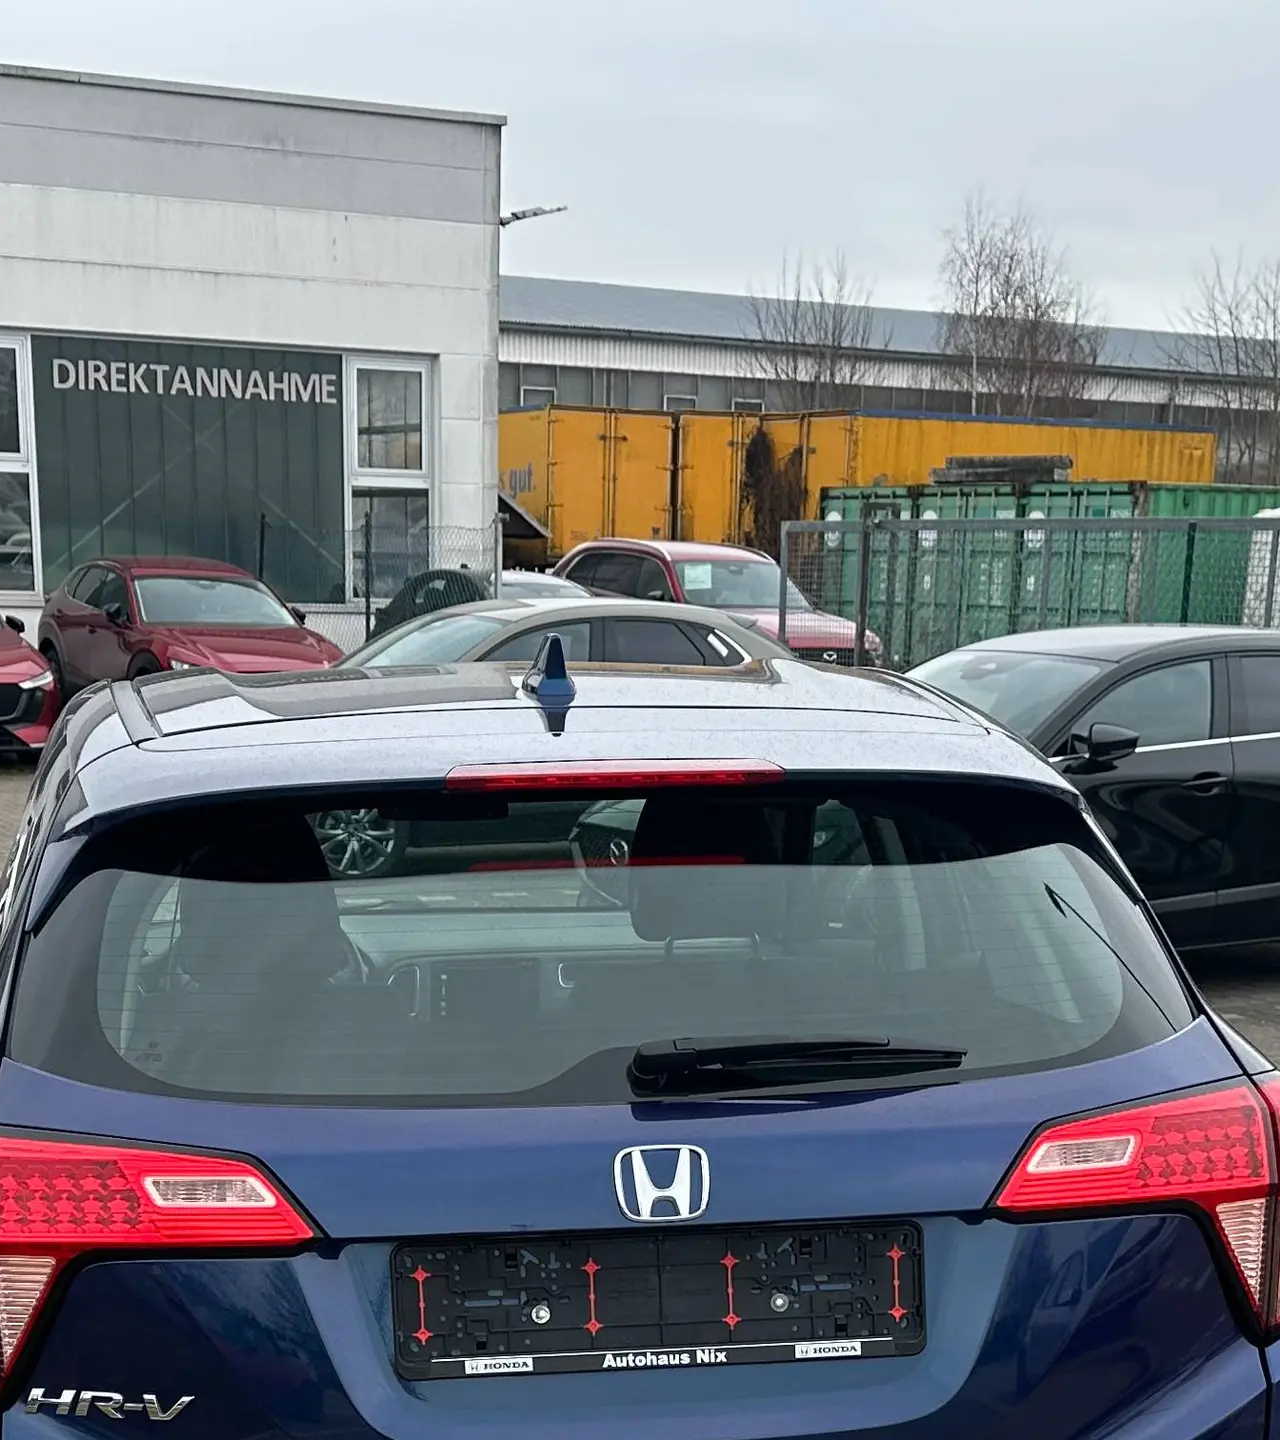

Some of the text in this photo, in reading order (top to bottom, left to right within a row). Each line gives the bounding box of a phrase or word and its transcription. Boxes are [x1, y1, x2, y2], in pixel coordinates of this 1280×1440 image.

[51, 358, 338, 404] DIREKTANNAHME
[602, 1348, 728, 1368] Autohaus Nix
[812, 1345, 858, 1355] HONDA
[483, 1361, 530, 1371] HONDA
[23, 1387, 196, 1421] HR-V
